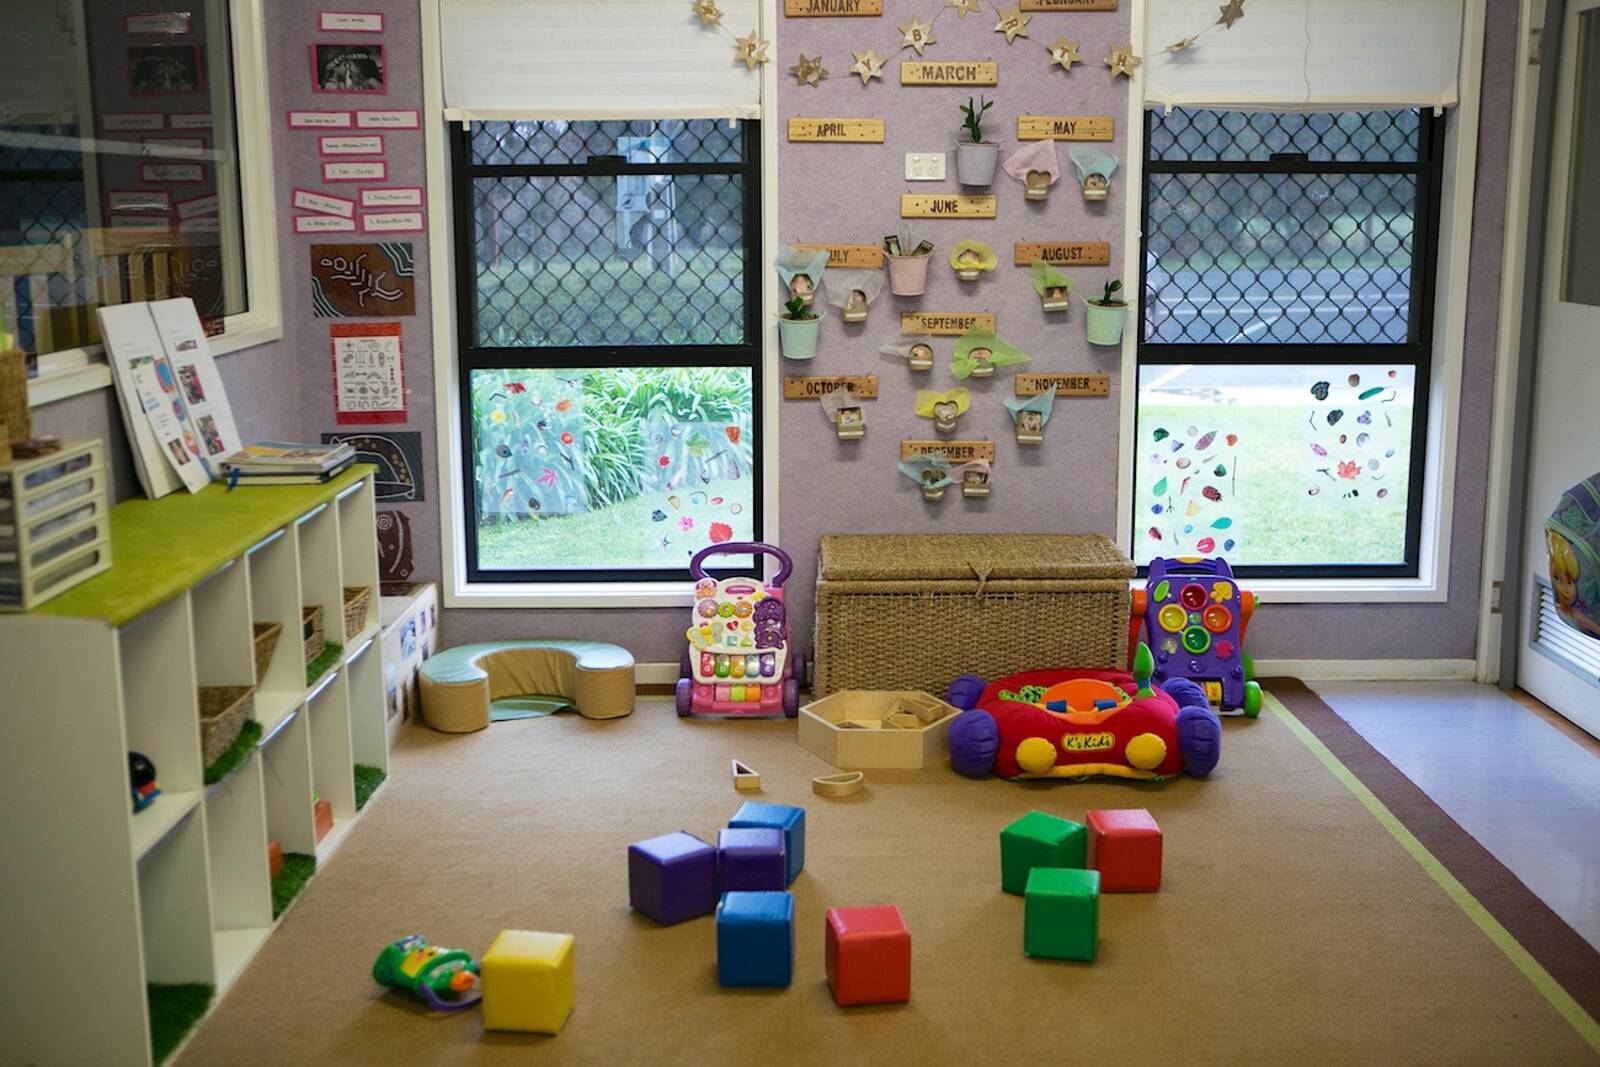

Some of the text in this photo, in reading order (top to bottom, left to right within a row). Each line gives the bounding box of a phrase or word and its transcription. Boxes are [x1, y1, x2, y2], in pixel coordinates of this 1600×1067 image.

[806, 0, 860, 13] JANUARY
[922, 65, 976, 81] MARCH
[816, 123, 847, 137] APRIL
[1053, 121, 1077, 135] MAY
[930, 199, 958, 213] JUNE
[829, 249, 849, 263] ULY
[1041, 246, 1083, 261] AUGUST
[1035, 377, 1090, 391] NOVEMBER
[1083, 735, 1110, 749] Kids
